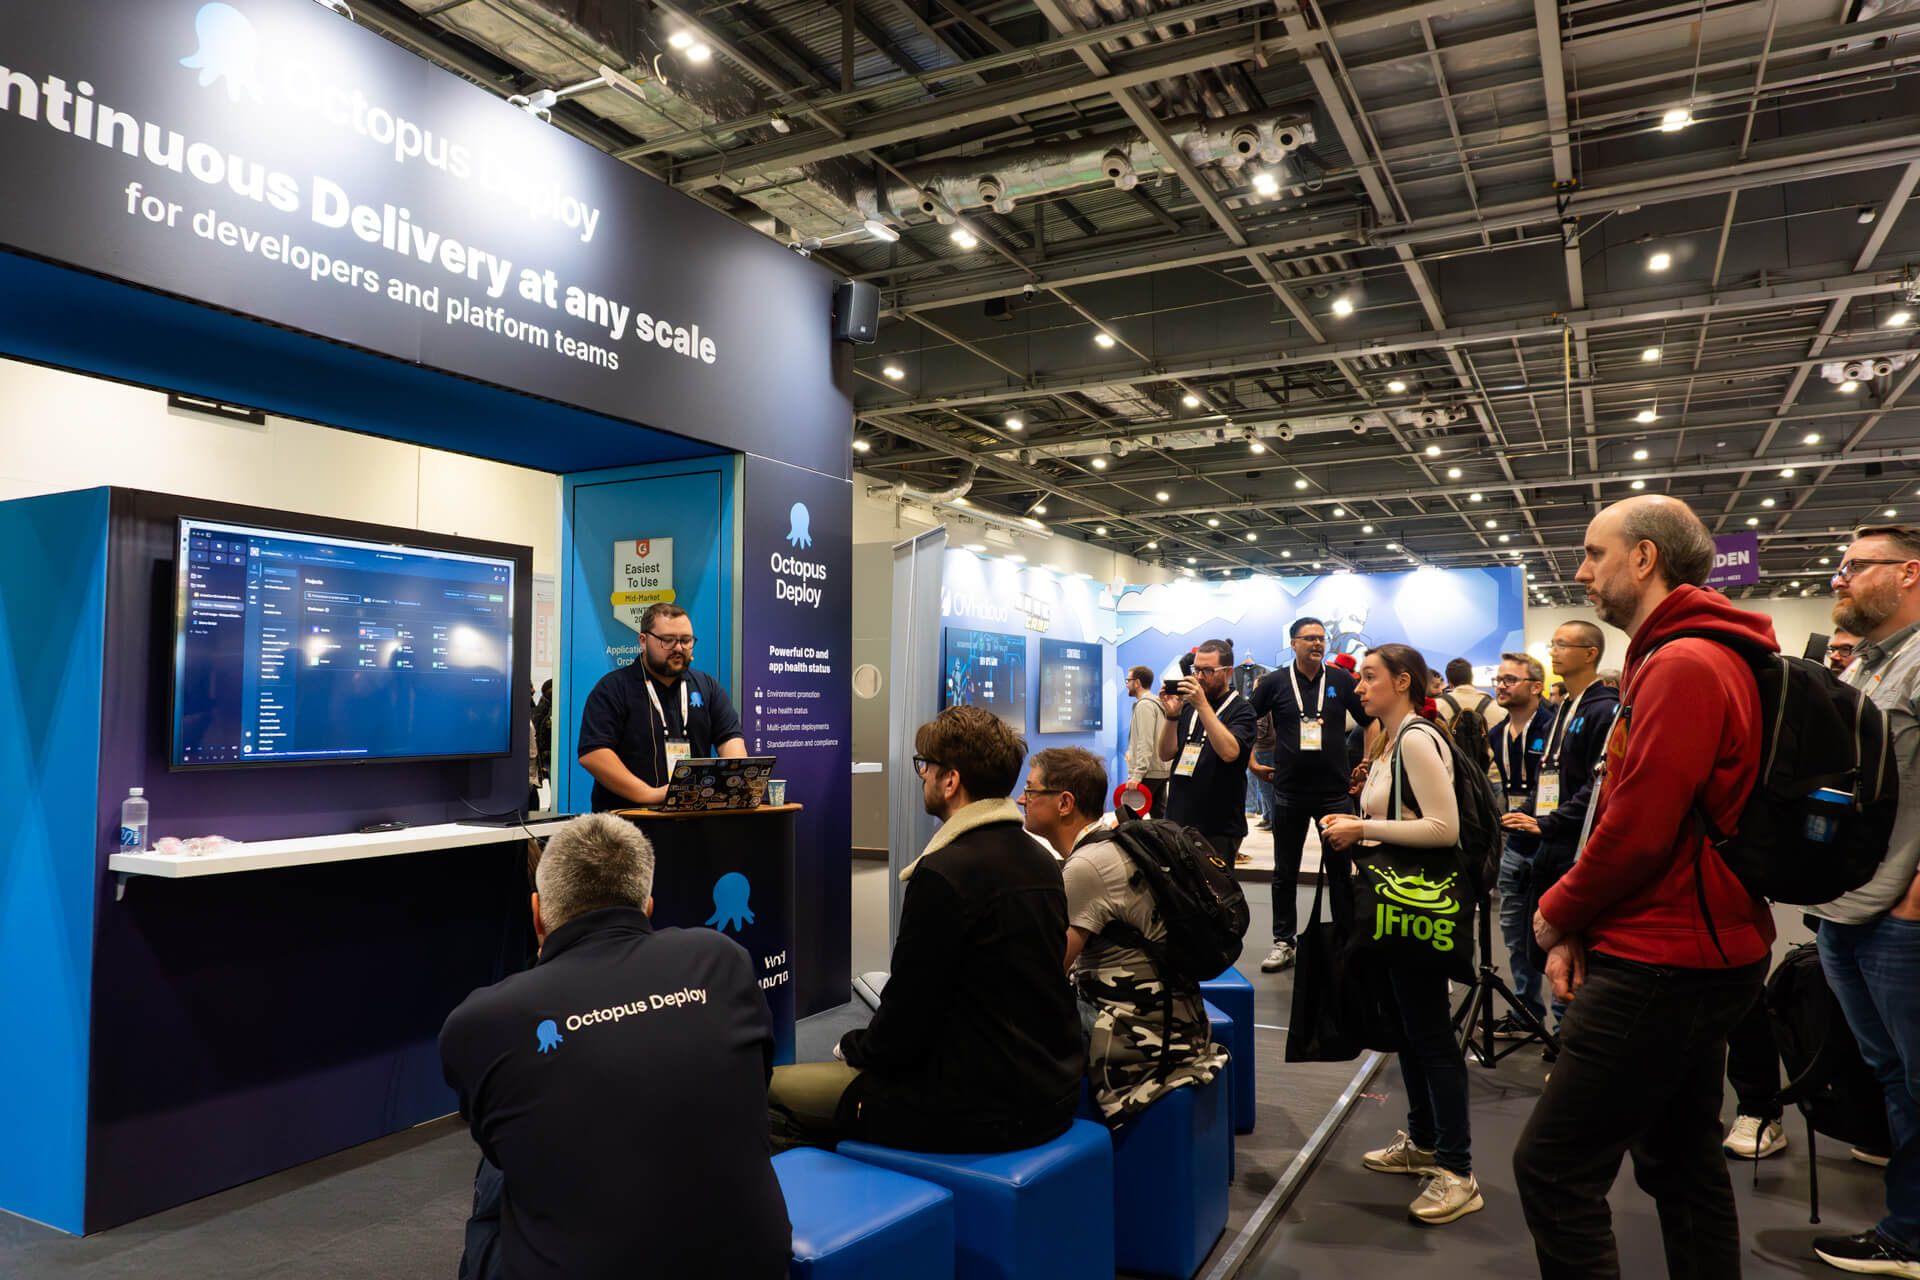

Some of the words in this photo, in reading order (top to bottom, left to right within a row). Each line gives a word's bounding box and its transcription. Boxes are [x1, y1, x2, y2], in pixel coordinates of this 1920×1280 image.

[282, 60, 472, 180] Octopus
[125, 182, 183, 227] for
[193, 209, 380, 293] developers
[387, 278, 439, 313] and
[446, 296, 548, 349] platform
[554, 330, 619, 370] teams
[311, 176, 512, 299] Delivery
[518, 268, 558, 309] at
[565, 286, 630, 340] any
[635, 312, 717, 364] scale
[1712, 550, 1751, 569] DEN
[625, 562, 660, 575] Easiest
[770, 552, 827, 582] Octopus
[627, 577, 639, 588] To
[640, 577, 659, 588] Use
[625, 593, 660, 602] Mid-Market
[776, 578, 822, 609] Deploy
[630, 607, 647, 615] WINT
[606, 645, 643, 656] Applicatio
[769, 645, 803, 657] Powerful
[803, 647, 815, 658] CD
[815, 648, 829, 659] and
[616, 656, 634, 666] Orch
[769, 662, 784, 674] app
[784, 661, 808, 673] health
[808, 663, 831, 673] status
[767, 689, 796, 698] Environment
[797, 690, 821, 699] promotion
[767, 706, 777, 715] Live
[778, 706, 793, 715] health
[794, 707, 809, 715] status
[767, 723, 800, 733] Multi-platform
[801, 723, 830, 733] deployments
[804, 739, 814, 747] and
[814, 739, 839, 747] compliance
[1372, 903, 1456, 951] JFrog
[566, 1000, 648, 1031] Octopus
[649, 987, 707, 1009] Deploy
